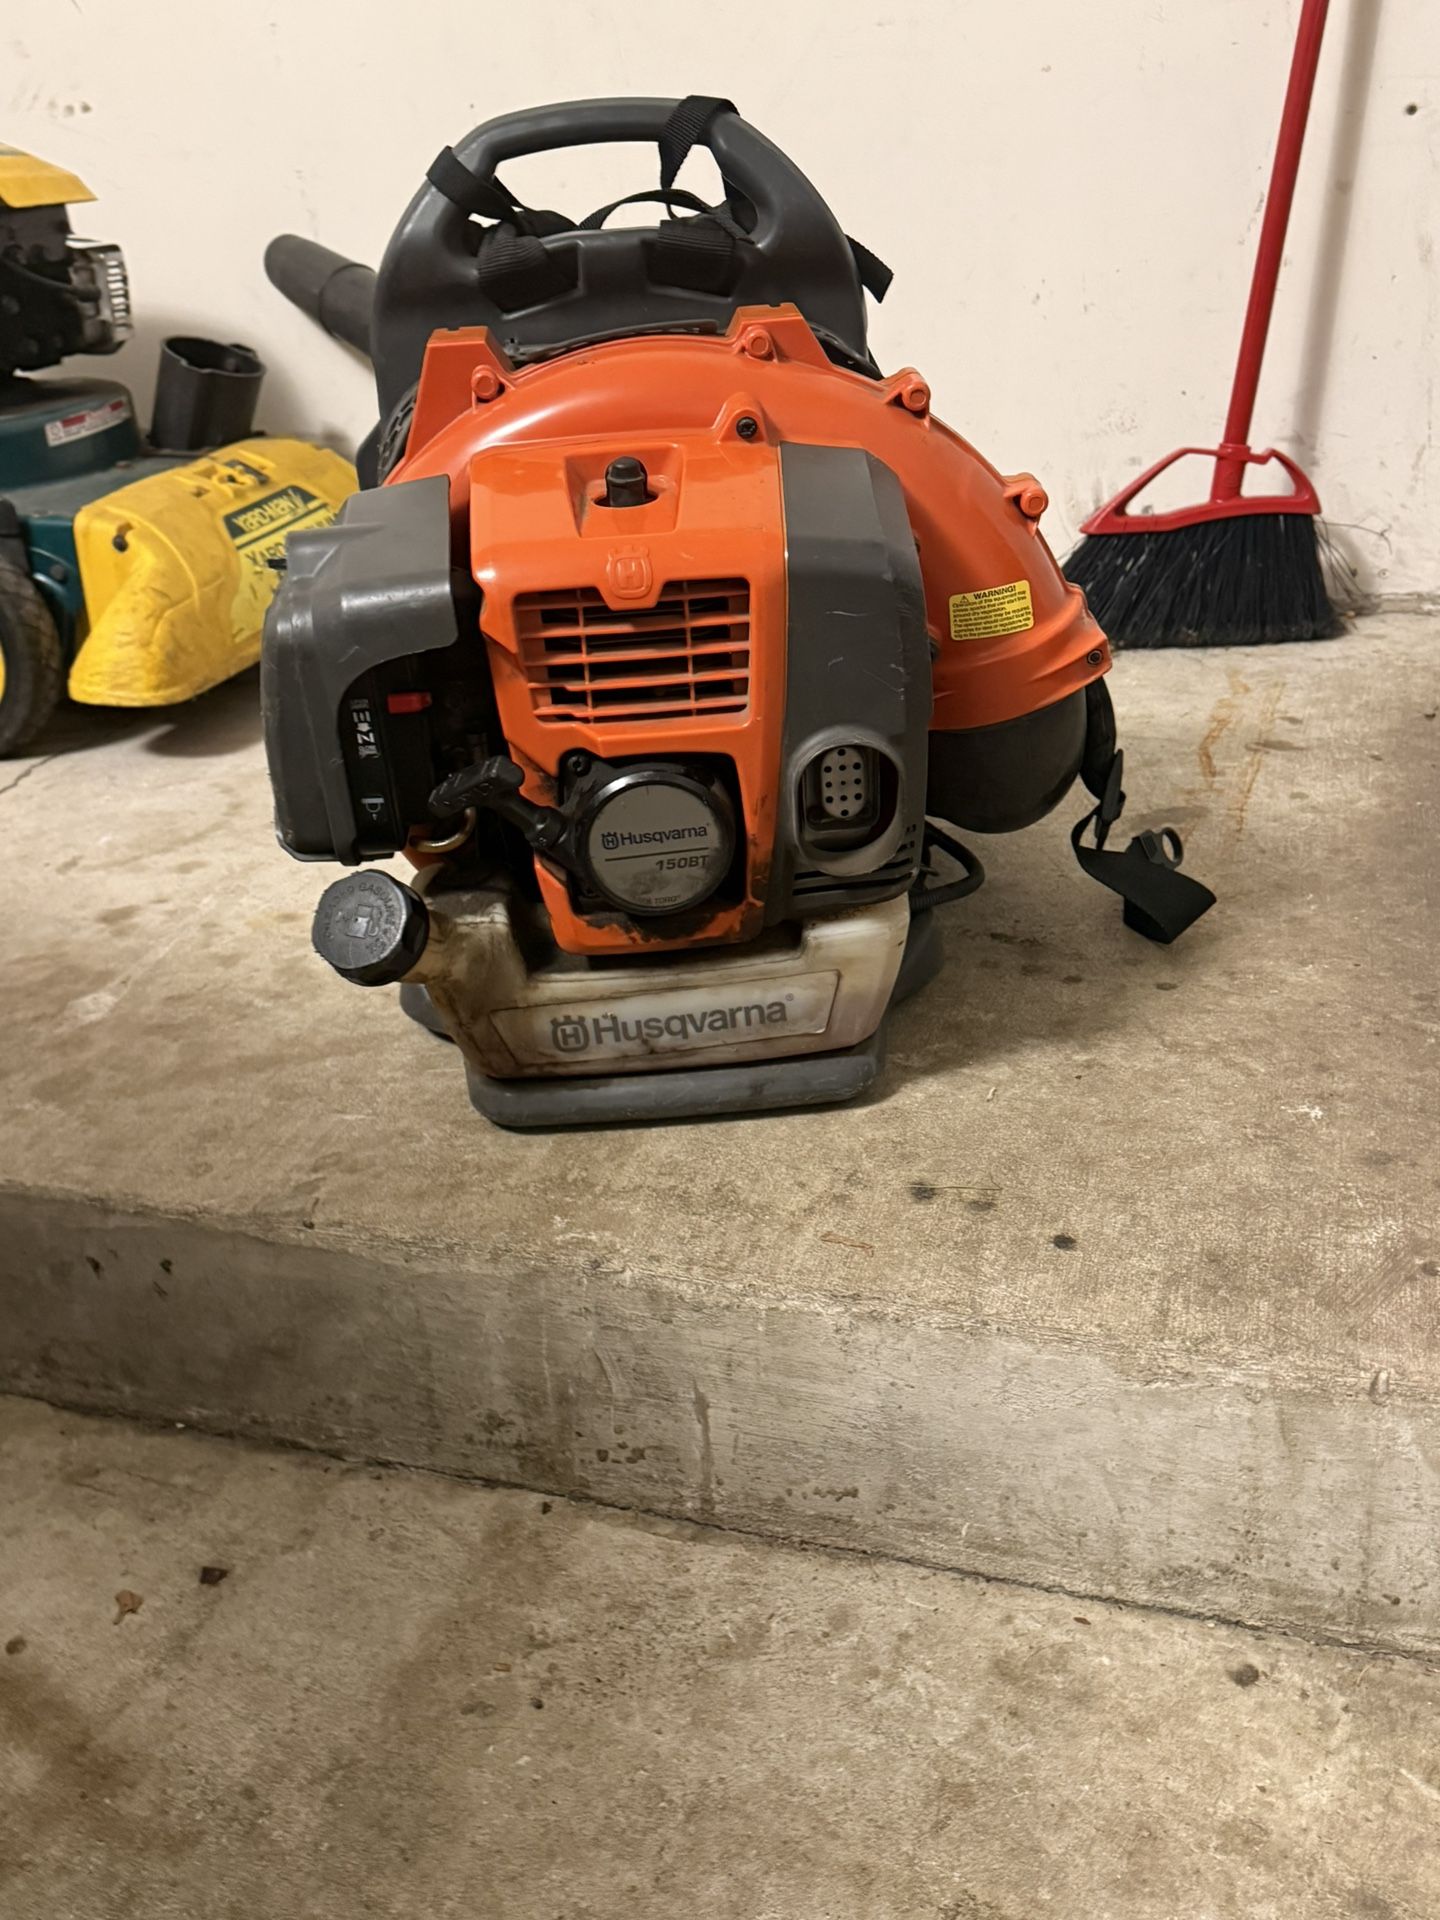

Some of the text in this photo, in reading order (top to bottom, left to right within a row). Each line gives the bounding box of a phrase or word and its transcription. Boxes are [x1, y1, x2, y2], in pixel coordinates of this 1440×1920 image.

[973, 585, 1016, 600] WARNING!
[620, 826, 708, 845] Husqvarna
[655, 855, 710, 871] 150BT
[592, 1000, 788, 1045] Husqvarna
